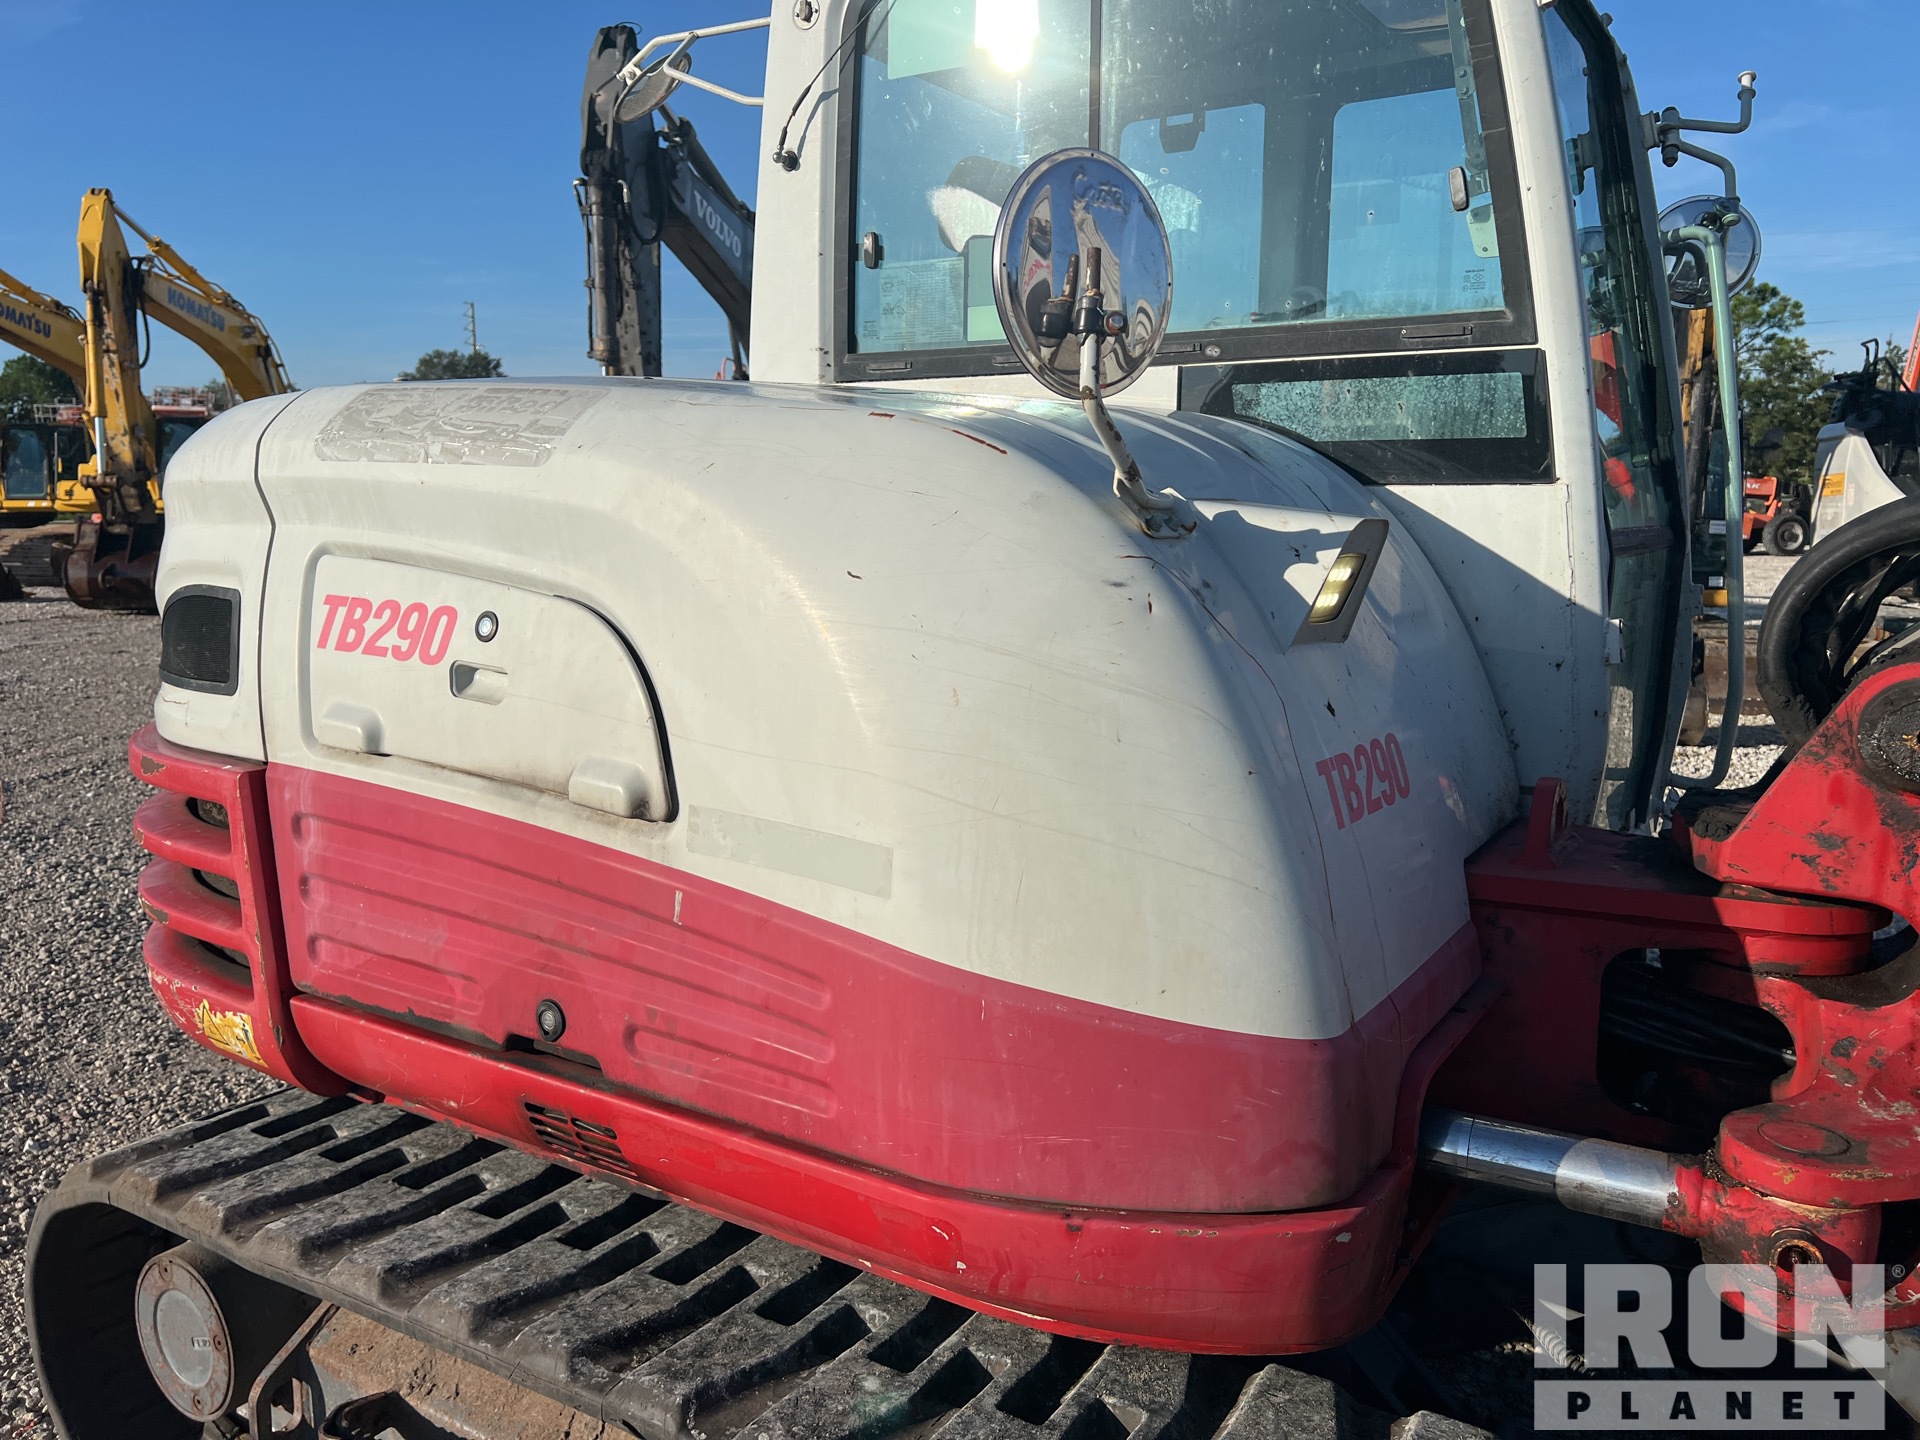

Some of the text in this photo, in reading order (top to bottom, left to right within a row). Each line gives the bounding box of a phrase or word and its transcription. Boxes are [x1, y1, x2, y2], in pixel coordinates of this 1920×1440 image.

[693, 189, 742, 258] VOLVO
[167, 285, 225, 333] KOMATSU
[316, 593, 459, 666] TB290
[1315, 732, 1411, 831] TB290
